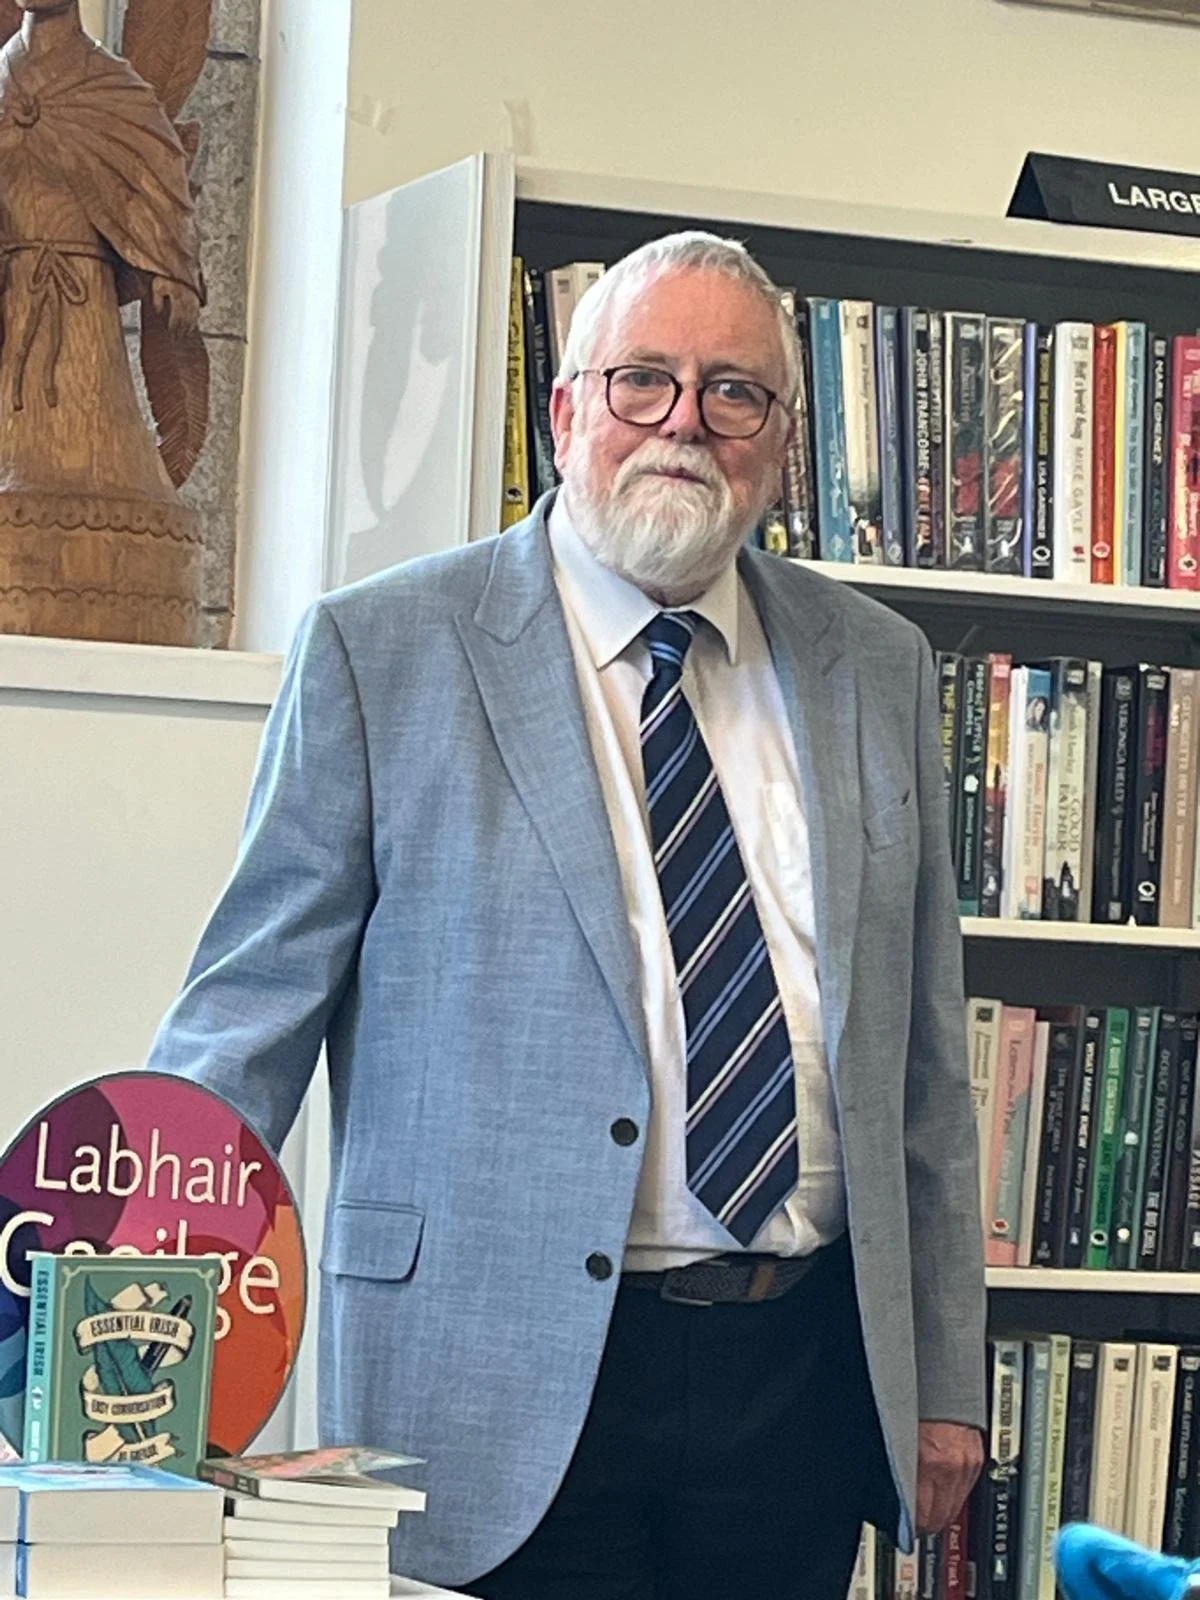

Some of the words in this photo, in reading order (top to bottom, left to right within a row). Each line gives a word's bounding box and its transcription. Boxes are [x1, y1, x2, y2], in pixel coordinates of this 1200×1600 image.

[1108, 182, 1200, 214] LARGE
[916, 349, 928, 388] JOHN
[1154, 360, 1165, 398] MARK
[917, 391, 929, 470] FRANCOME
[1152, 401, 1164, 465] GIMENEZ
[1038, 460, 1047, 485] LISA
[1075, 446, 1084, 479] MIKE
[1038, 487, 1047, 538] GARDNER
[1074, 487, 1084, 533] GAYLE
[975, 663, 986, 715] PERFECT
[972, 716, 983, 752] LITTLE
[1115, 703, 1129, 764] VERONICA
[1177, 696, 1191, 770] GEORGETTE
[1176, 773, 1188, 816] HEYER
[1058, 784, 1070, 851] FATHER
[1069, 798, 1081, 852] GOOD
[1085, 1042, 1095, 1074] WHAT
[1112, 1037, 1122, 1045] A
[1008, 1040, 1022, 1081] Letters
[1109, 1047, 1121, 1076] QUIET
[1157, 1049, 1170, 1092] DOUG
[1181, 1060, 1191, 1082] OUT
[1081, 1076, 1094, 1112] MAISIE
[1105, 1079, 1119, 1135] CONTAGION
[1003, 1110, 1017, 1135] Past
[1078, 1114, 1090, 1149] KNEW
[1150, 1096, 1168, 1179] JOHNSTONE
[1174, 1117, 1187, 1151] COLD
[34, 1121, 262, 1208] Labhair
[1075, 1156, 1088, 1187] Henry
[1144, 1210, 1158, 1227] BIG
[1147, 1191, 1161, 1209] THE
[1141, 1228, 1157, 1256] CHILL
[35, 1270, 50, 1335] ESSENTIAL
[90, 1314, 145, 1337] ESSENTIAL
[149, 1317, 180, 1339] IRISH
[33, 1341, 46, 1377] IRISH
[1000, 1374, 1014, 1427] DENNIS
[1054, 1373, 1065, 1395] Just
[1183, 1376, 1194, 1411] CLARE
[1053, 1397, 1064, 1425] Like
[1050, 1429, 1061, 1473] Heaven
[1047, 1480, 1058, 1518] MARC
[994, 1492, 1008, 1553] SACRED
[947, 1553, 961, 1588] Track
